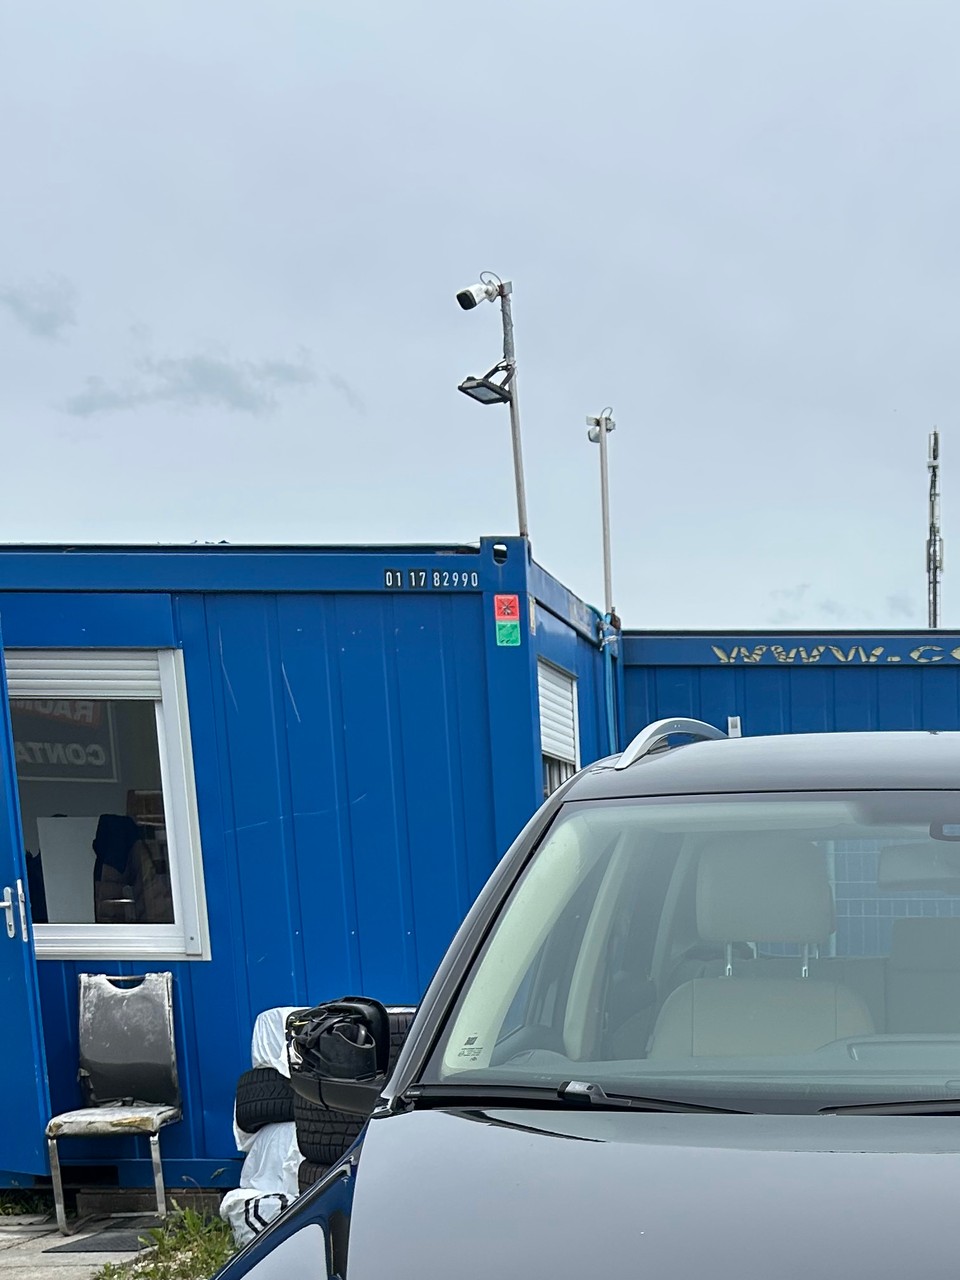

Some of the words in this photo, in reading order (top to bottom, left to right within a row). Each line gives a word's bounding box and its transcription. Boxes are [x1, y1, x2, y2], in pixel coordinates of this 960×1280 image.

[385, 571, 401, 587] 01
[410, 571, 426, 587] 17
[433, 571, 478, 588] 82990
